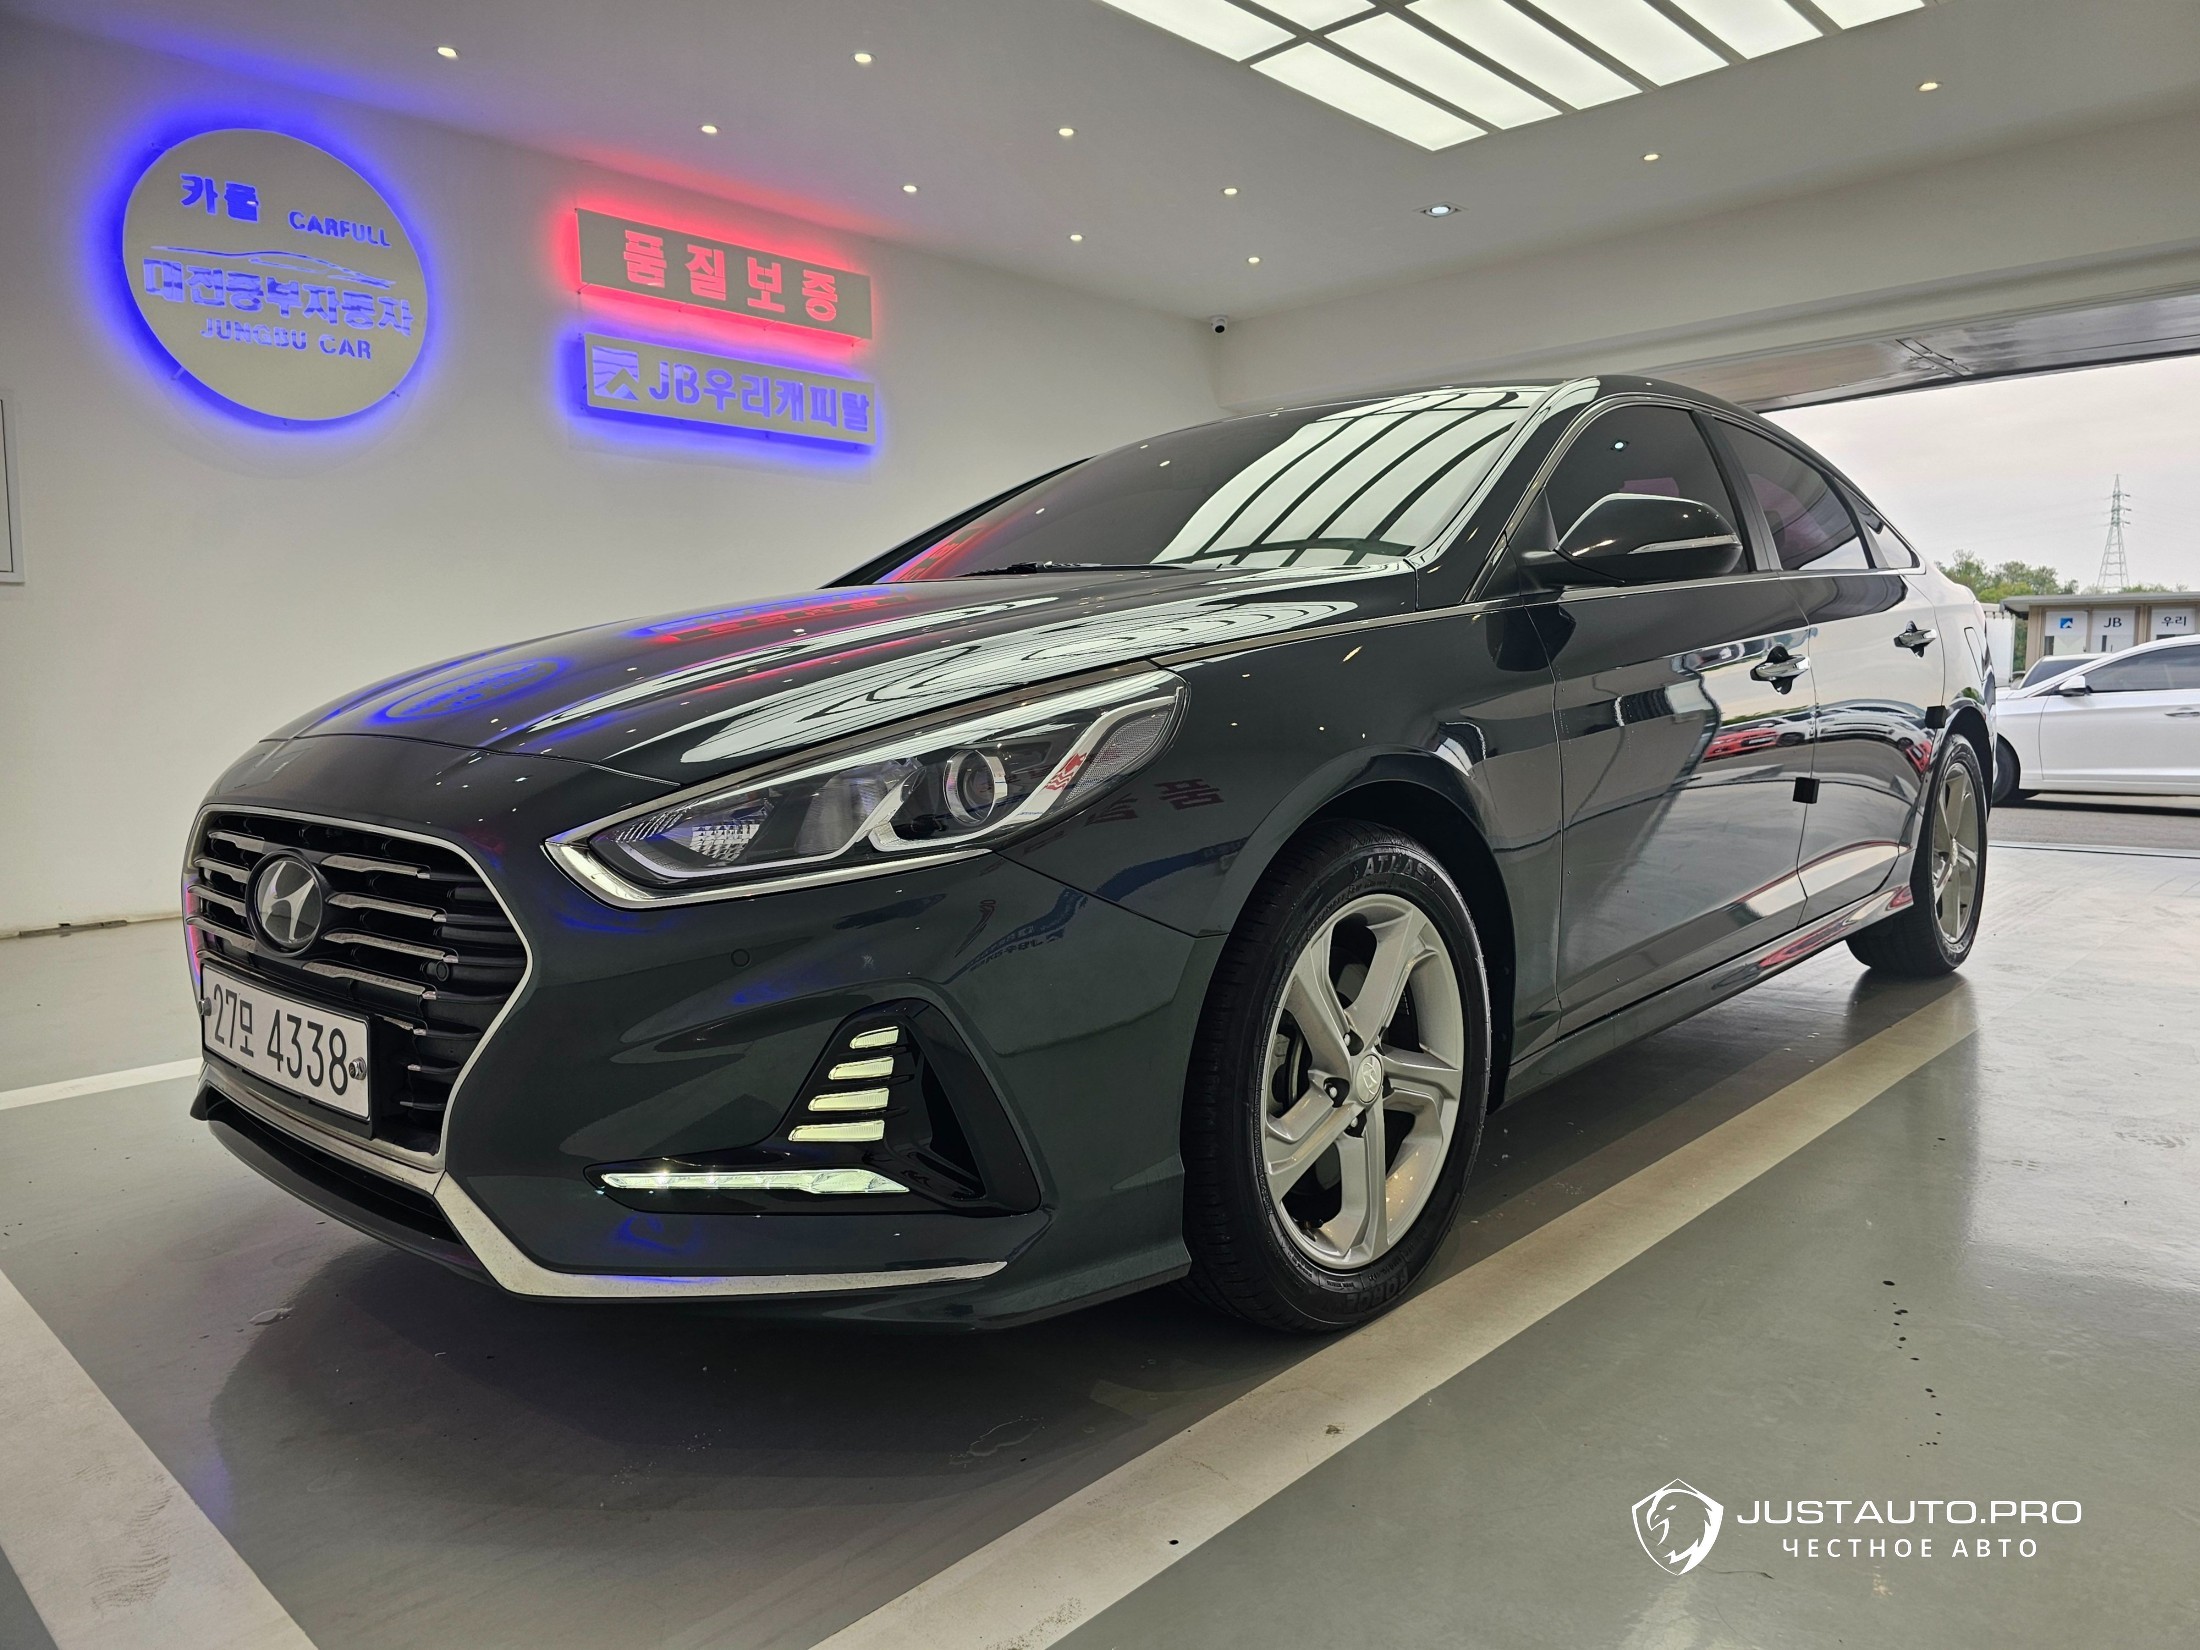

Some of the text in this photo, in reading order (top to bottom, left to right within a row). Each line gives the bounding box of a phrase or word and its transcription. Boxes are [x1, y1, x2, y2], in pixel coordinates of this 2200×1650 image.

[288, 211, 393, 247] CARFULL
[201, 318, 372, 360] JUNGBU CAR
[2103, 615, 2187, 628] JB 우리
[1362, 854, 1428, 879] ATLAS
[212, 983, 349, 1097] 27모 4338
